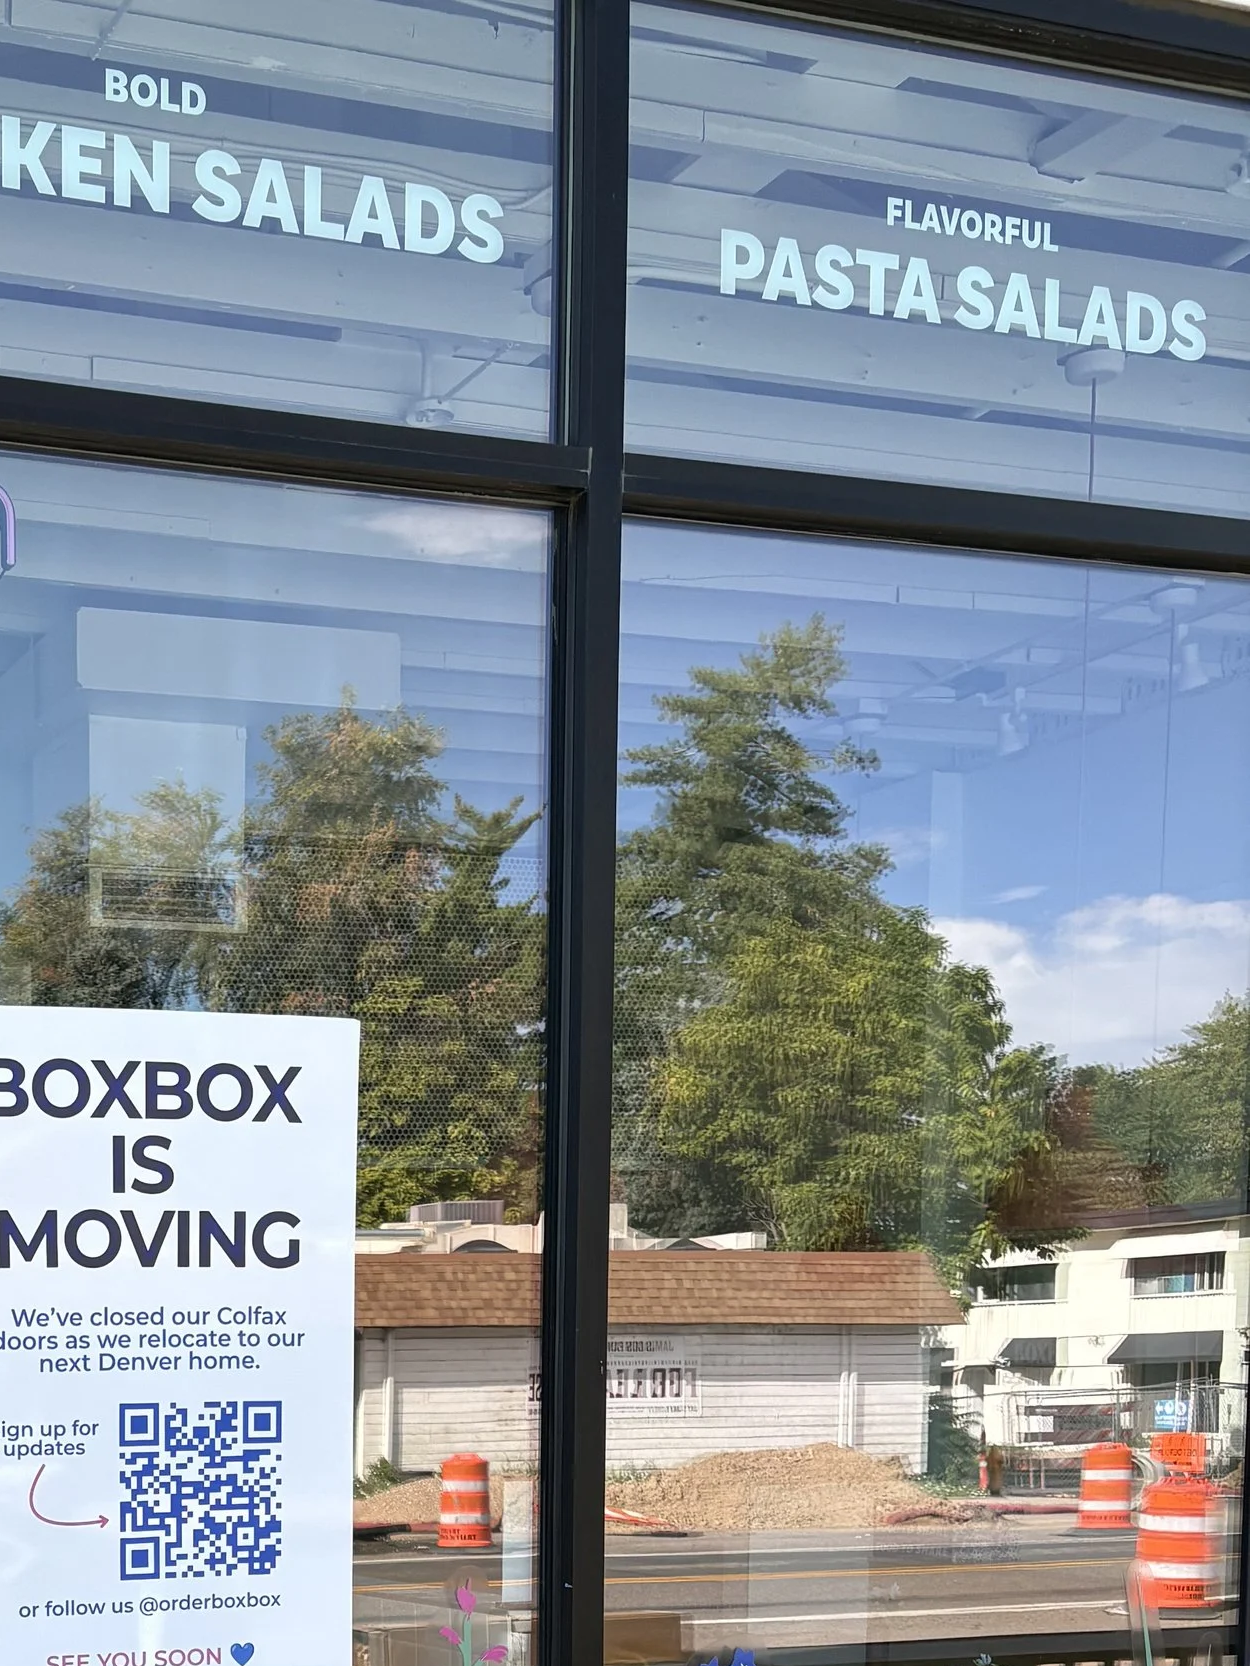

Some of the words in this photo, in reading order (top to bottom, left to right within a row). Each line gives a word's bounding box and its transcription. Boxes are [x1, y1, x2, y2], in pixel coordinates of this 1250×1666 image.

[105, 67, 207, 117] BOLD
[191, 149, 505, 264] SALADS
[886, 197, 1059, 253] FLAVORFUL
[720, 229, 941, 325] PASTA
[954, 266, 1207, 362] SALADS
[112, 1135, 175, 1195] IS
[11, 1308, 83, 1327] We’ve
[90, 1307, 164, 1327] closed
[172, 1310, 210, 1325] our
[217, 1306, 287, 1326] Colfax
[65, 1335, 91, 1350] as
[97, 1333, 131, 1350] we
[139, 1328, 231, 1349] relocate
[237, 1331, 261, 1347] to
[267, 1331, 305, 1348] our
[39, 1355, 91, 1373] next
[99, 1352, 182, 1373] Denver
[189, 1351, 261, 1371] home.
[40, 1425, 66, 1442] up
[71, 1420, 99, 1437] for
[3, 1440, 86, 1461] updates
[18, 1603, 40, 1618] or
[45, 1599, 106, 1617] follow
[111, 1600, 134, 1615] us
[139, 1592, 282, 1618] @orderboxbox
